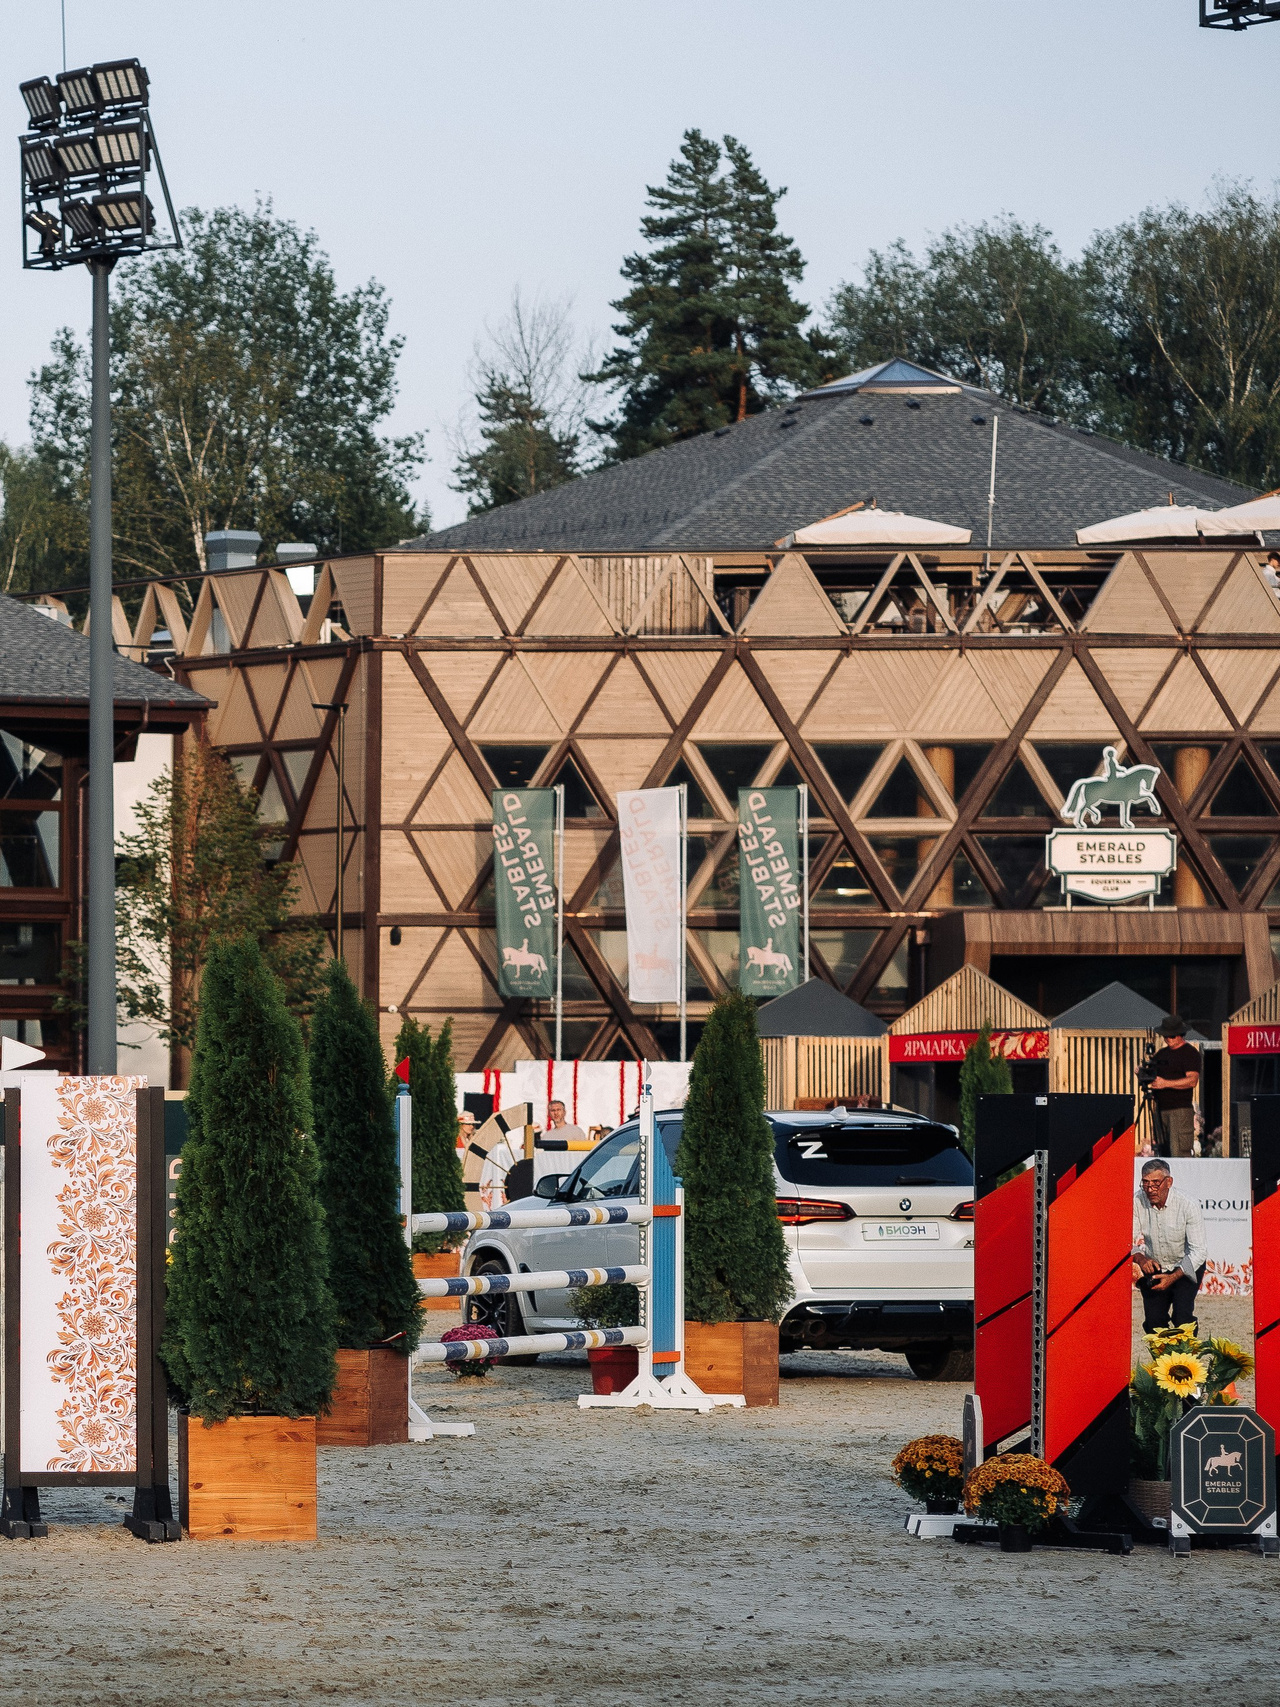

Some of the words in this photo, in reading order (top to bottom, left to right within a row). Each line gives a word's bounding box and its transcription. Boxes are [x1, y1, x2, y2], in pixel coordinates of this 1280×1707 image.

[1076, 842, 1146, 852] EMERALD
[1080, 854, 1142, 864] STABLES
[903, 1039, 967, 1056] ЯРМАРКА
[797, 1141, 829, 1160] Z
[886, 1225, 926, 1235] БИОЭН
